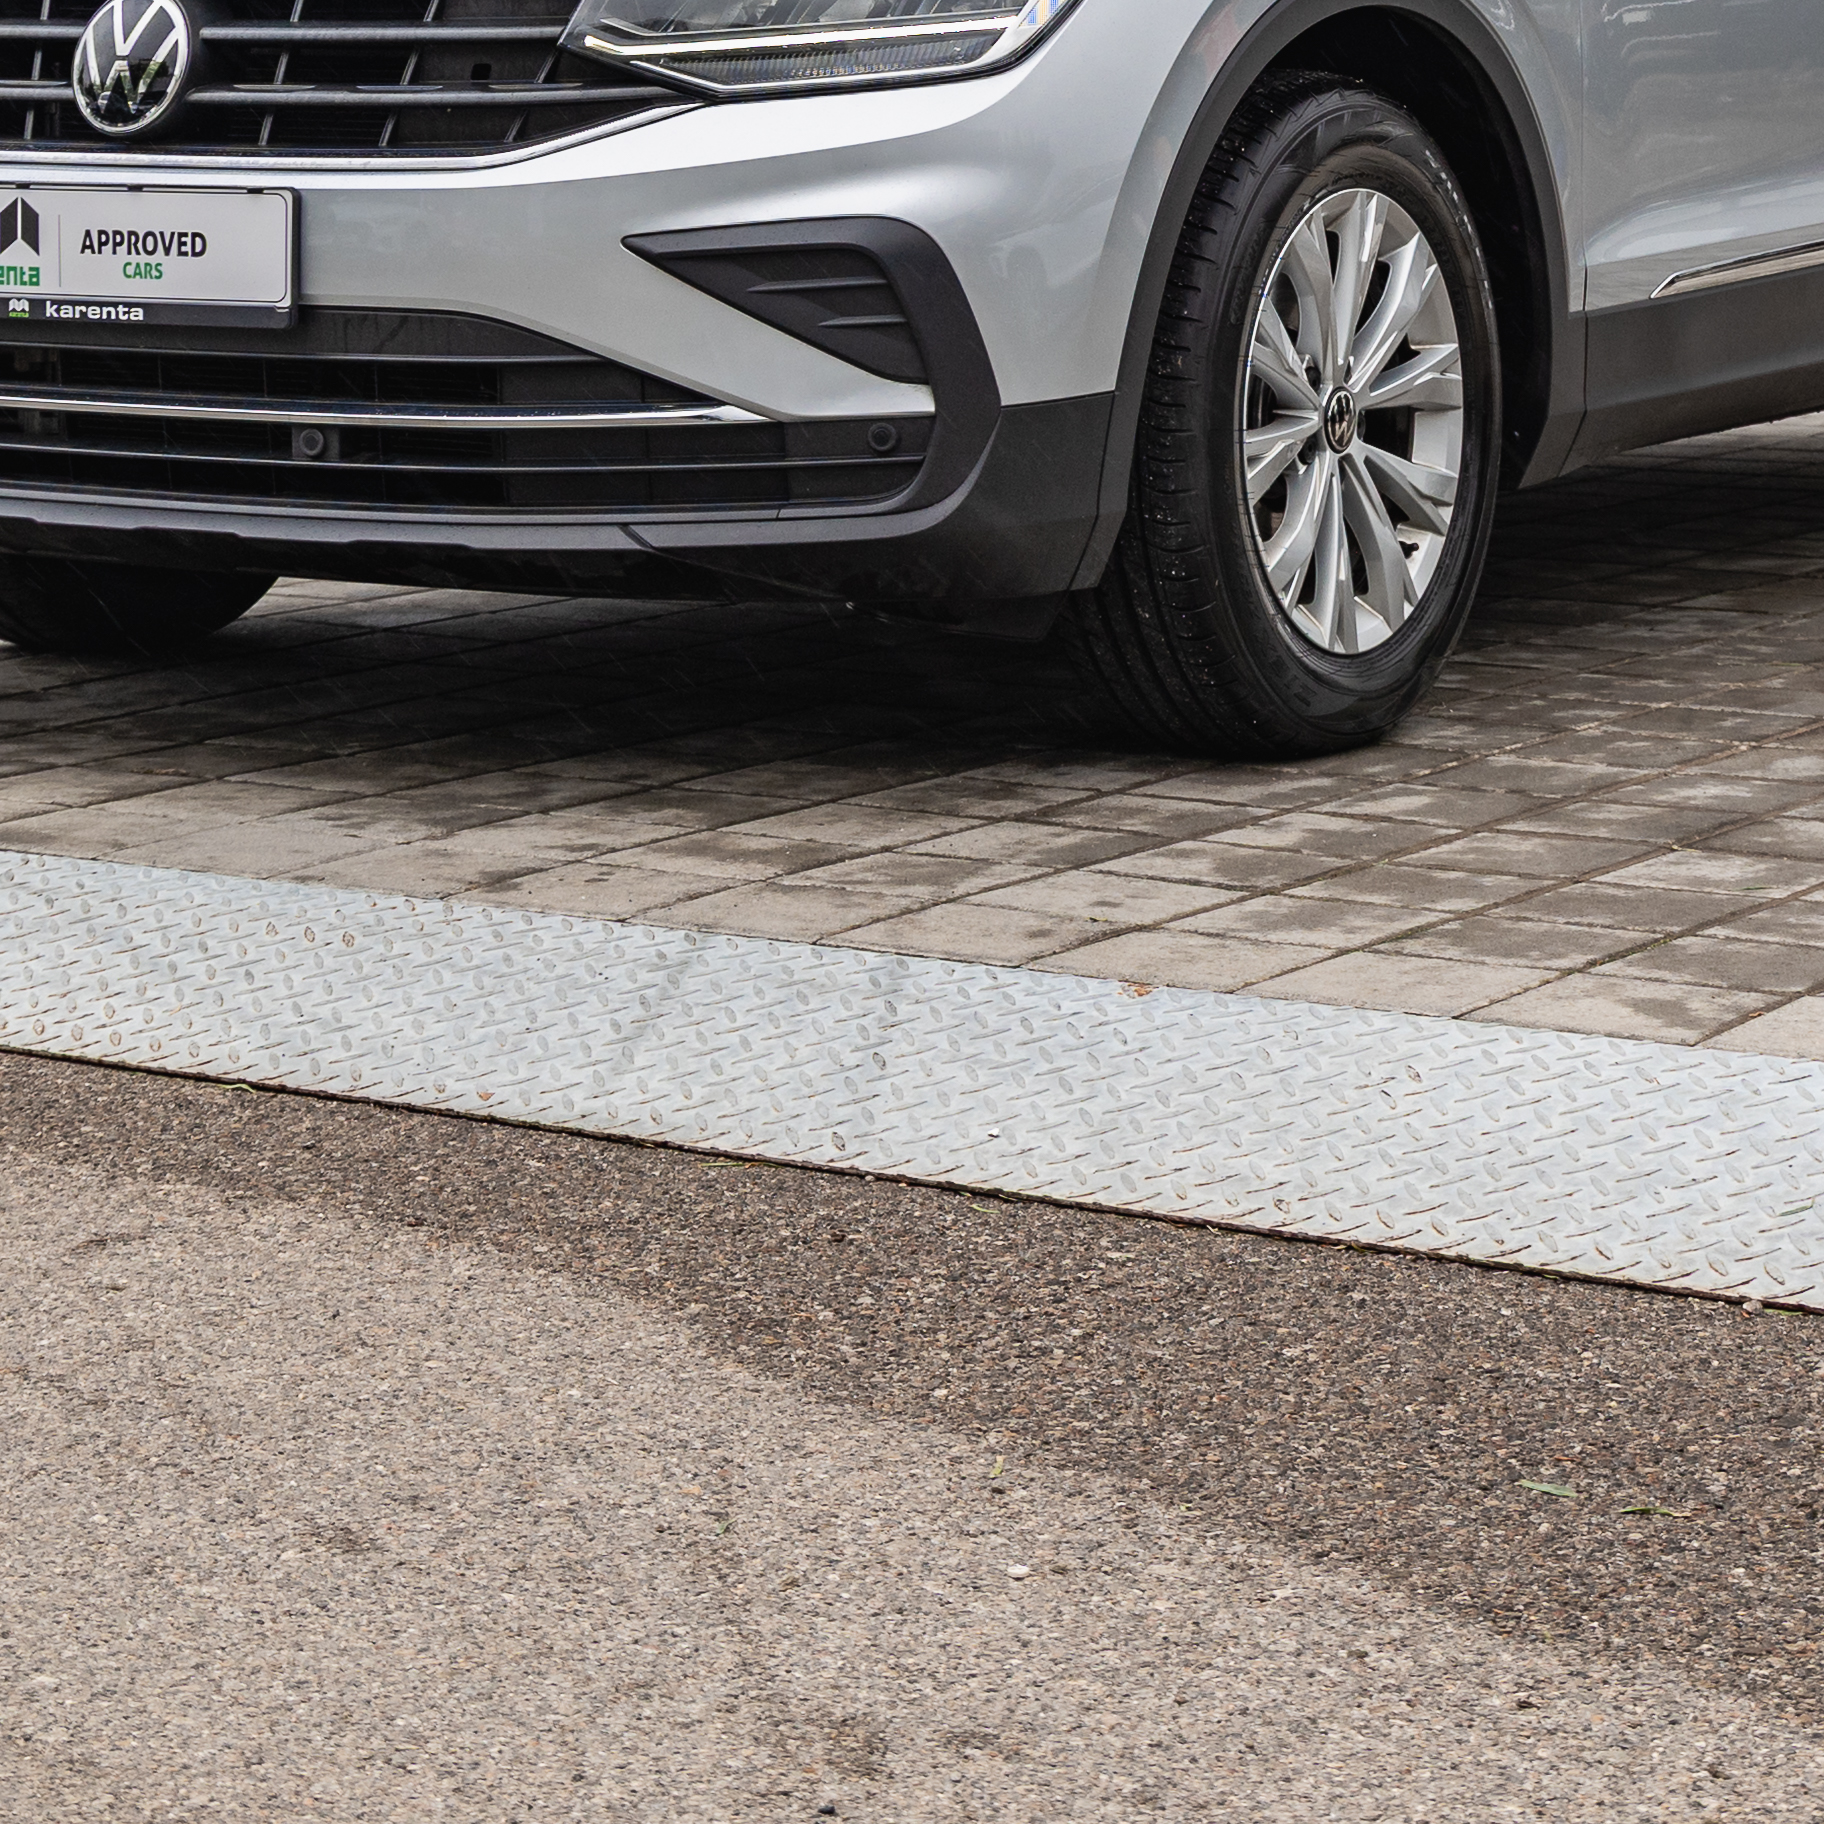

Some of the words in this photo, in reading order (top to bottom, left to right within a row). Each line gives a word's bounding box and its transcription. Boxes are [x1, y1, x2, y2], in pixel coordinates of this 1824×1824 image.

[80, 229, 207, 258] APPROVED
[122, 262, 164, 280] CARS
[45, 300, 145, 321] karenta
